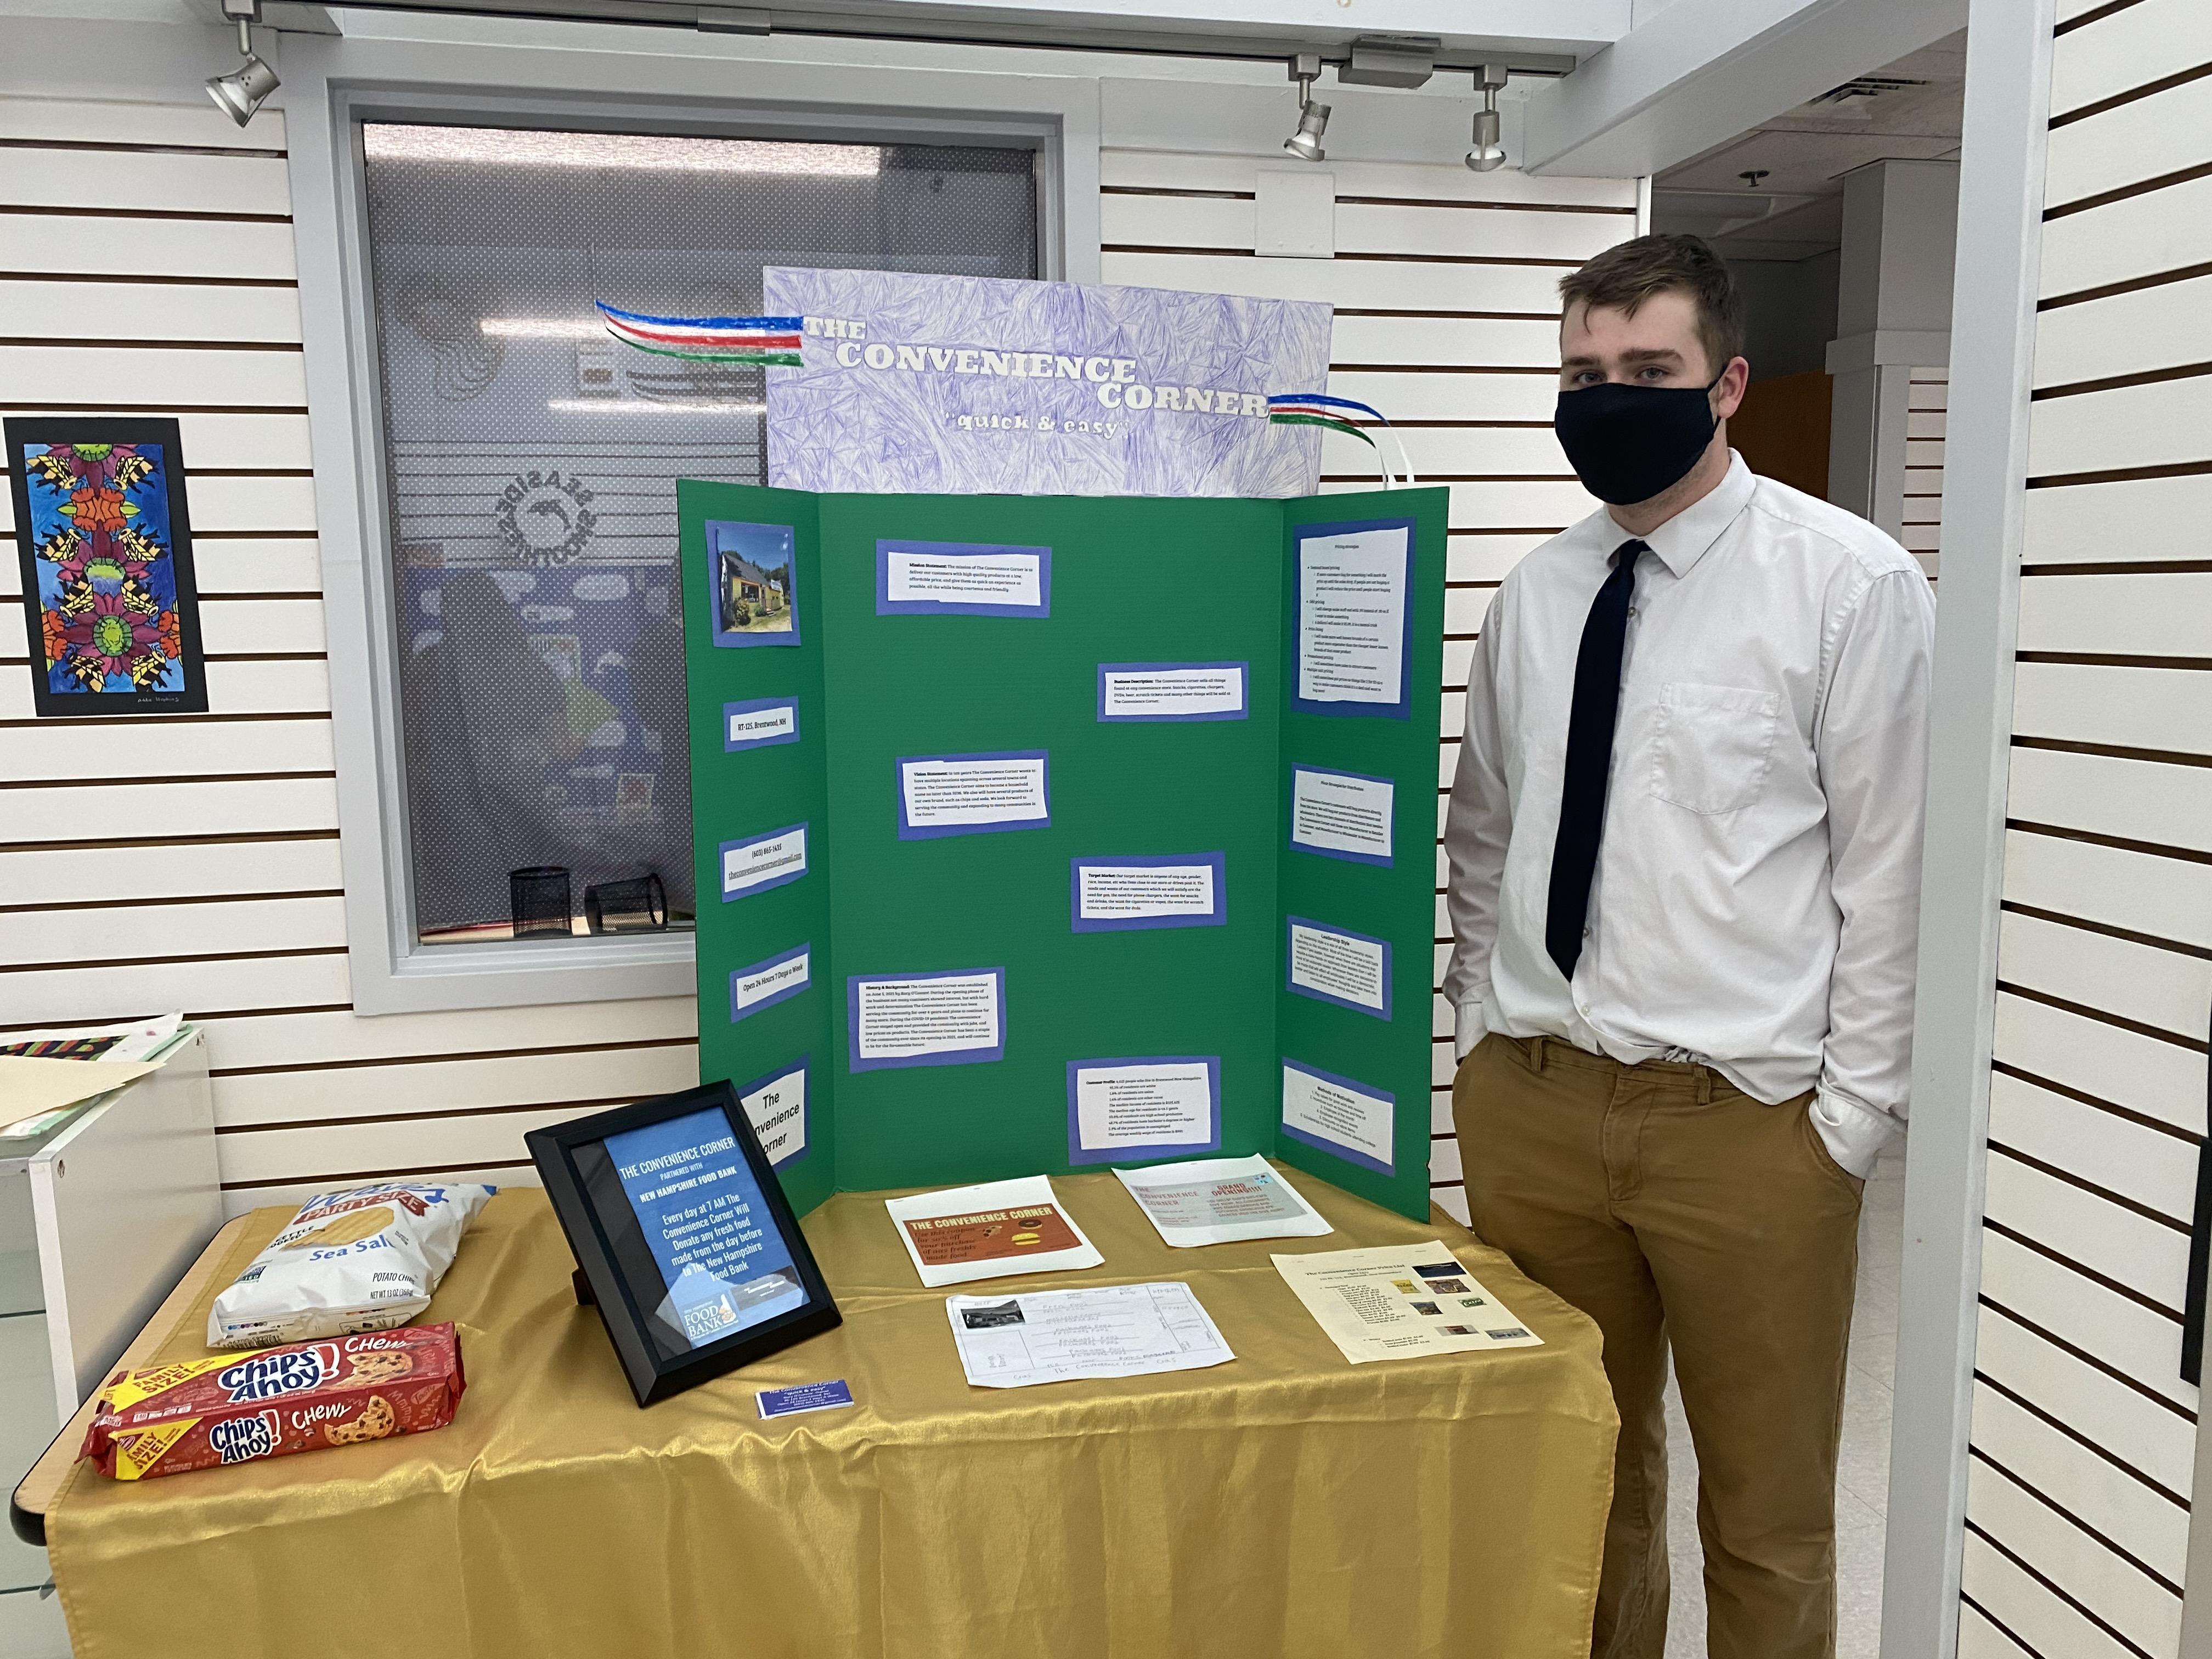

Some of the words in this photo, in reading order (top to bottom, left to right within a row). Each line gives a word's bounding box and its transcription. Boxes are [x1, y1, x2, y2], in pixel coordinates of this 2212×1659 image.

[803, 316, 866, 340] THE
[834, 342, 1137, 384] CONVENIENCE
[1097, 382, 1271, 418] CORNER
[1037, 415, 1056, 431] &
[752, 849, 763, 859] (603)
[743, 983, 755, 992] Open
[761, 975, 775, 985] Hours
[778, 970, 789, 979] Days
[792, 963, 803, 973] Week
[763, 1092, 780, 1110] The
[754, 1103, 799, 1136] nvenience
[763, 1132, 787, 1154] orner
[619, 1165, 640, 1180] THE
[639, 1147, 701, 1174] CONVENIENCE
[699, 1137, 736, 1156] CORNER
[660, 1166, 690, 1181] PARTNERED
[690, 1162, 703, 1173] WITH
[640, 1191, 656, 1203] NEW
[656, 1178, 698, 1198] HAMPSHIRE
[698, 1172, 717, 1185] FOOD
[717, 1166, 737, 1179] BANK
[1139, 1190, 1199, 1199] CONVENIENCE
[303, 1197, 374, 1221] PARTY
[375, 1191, 423, 1211] SIZE
[662, 1214, 684, 1226] Every
[684, 1208, 698, 1219] day
[698, 1204, 707, 1214] at
[706, 1201, 712, 1211] 7
[713, 1197, 726, 1209] AM
[725, 1193, 741, 1205] The
[662, 1218, 709, 1240] Convenience
[709, 1210, 734, 1224] Corner
[733, 1203, 751, 1216] Will
[910, 1221, 933, 1231] THE
[934, 1212, 1008, 1229] CONVENIENCE
[1009, 1207, 1053, 1220] CORNER
[672, 1235, 700, 1251] Donate
[700, 1231, 714, 1241] any
[714, 1222, 735, 1237] fresh
[734, 1216, 751, 1231] food
[309, 1248, 348, 1261] Sea
[671, 1251, 693, 1267] made
[692, 1246, 712, 1259] from
[711, 1242, 725, 1252] the
[725, 1235, 739, 1247] day
[738, 1228, 763, 1243] before
[682, 1267, 692, 1277] to
[691, 1262, 707, 1274] The
[706, 1256, 723, 1269] New
[723, 1242, 763, 1263] Hampshire
[373, 1272, 398, 1282] POTATO
[709, 1268, 729, 1282] Food
[727, 1260, 749, 1276] Bank
[370, 1291, 378, 1299] NET
[379, 1290, 386, 1299] WT
[387, 1289, 392, 1297] 13
[1463, 1298, 1481, 1306] Extra
[684, 1305, 719, 1327] FOOD
[688, 1316, 723, 1338] BANK
[133, 1364, 184, 1387] FAMILY
[142, 1368, 195, 1393] SIZE!
[221, 1351, 317, 1388] Chips
[211, 1417, 267, 1450] Chips
